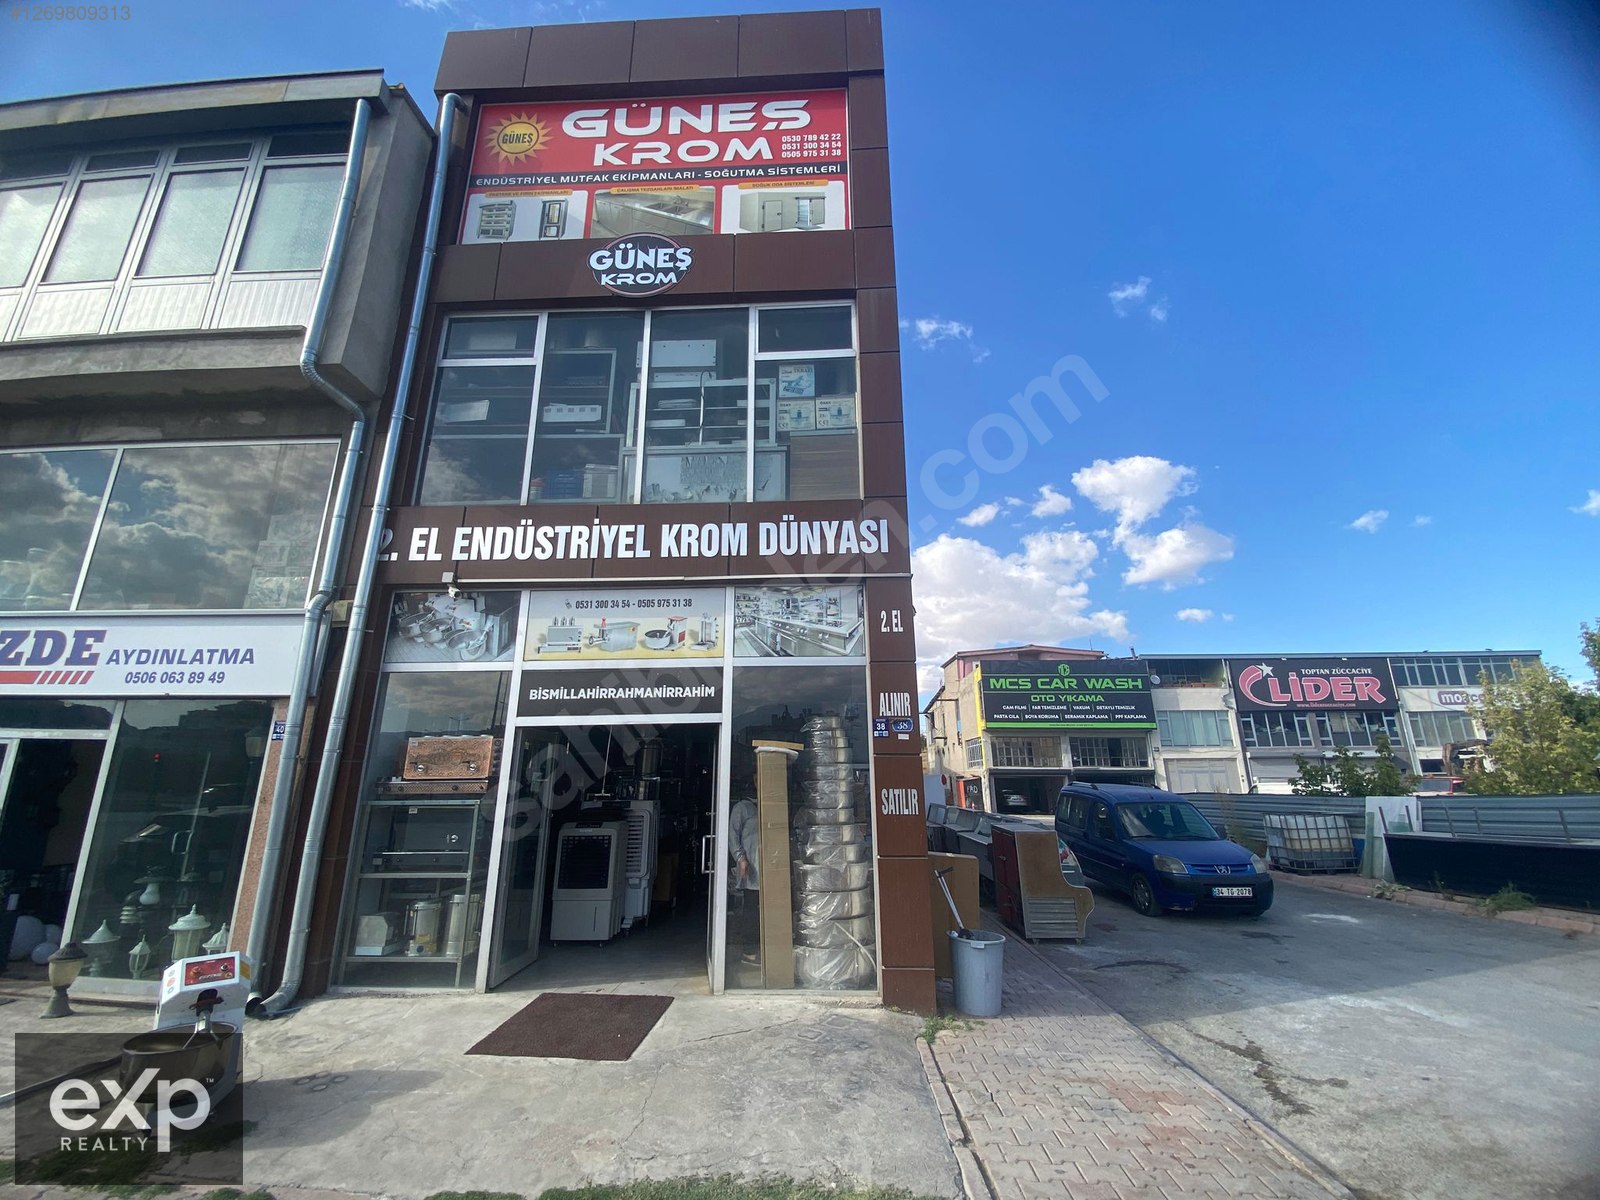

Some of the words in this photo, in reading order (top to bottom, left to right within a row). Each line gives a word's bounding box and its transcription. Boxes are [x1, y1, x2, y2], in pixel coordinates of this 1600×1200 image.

[562, 100, 811, 138] GÜNEŞ
[502, 131, 534, 147] GÜNEŞ
[781, 135, 801, 143] 0530
[803, 134, 817, 142] 789
[831, 133, 841, 141] 22
[781, 142, 801, 151] 0531
[803, 142, 818, 150] 300
[819, 141, 830, 149] 34
[831, 141, 842, 149] 54
[594, 136, 773, 166] KROM
[781, 150, 801, 159] 0505
[803, 149, 818, 158] 975
[819, 149, 829, 157] 31
[831, 149, 842, 157] 38
[476, 175, 557, 186] ENDÜSTRİYEL
[560, 174, 609, 184] MUTFAK
[612, 171, 695, 182] EKİPMANLARI
[704, 168, 765, 178] SOĞUTMA
[767, 164, 841, 175] SİSTEMLERİ
[589, 243, 692, 271] GÜNEŞ
[600, 272, 678, 286] KROM
[408, 527, 442, 561] EL
[451, 518, 651, 561] ENDÜSTRİYEL
[660, 522, 748, 558] KROM
[759, 514, 888, 556] DÜNYASI
[575, 600, 593, 609] 0531
[595, 600, 609, 609] 300
[610, 599, 620, 609] 34
[621, 599, 631, 608] 54
[637, 599, 655, 608] 0505
[657, 598, 671, 608] 975
[672, 598, 681, 607] 31
[682, 598, 693, 607] 38
[892, 609, 904, 632] EL
[106, 648, 255, 665] AYDINLATMA
[124, 671, 156, 684] 0506
[159, 671, 184, 684] 063
[188, 671, 205, 684] 89
[208, 671, 226, 684] 49
[989, 678, 1031, 689] MCS
[1037, 678, 1079, 689] CAR
[1083, 678, 1143, 689] WASH
[529, 684, 715, 700] BİSMİLLAHİRRAHMANİRRAHİM
[1268, 672, 1387, 704] LİDER
[879, 692, 911, 716] ALINIR
[1030, 694, 1056, 702] OTO
[1058, 694, 1105, 702] YIKAMA
[881, 788, 919, 815] SATILIR
